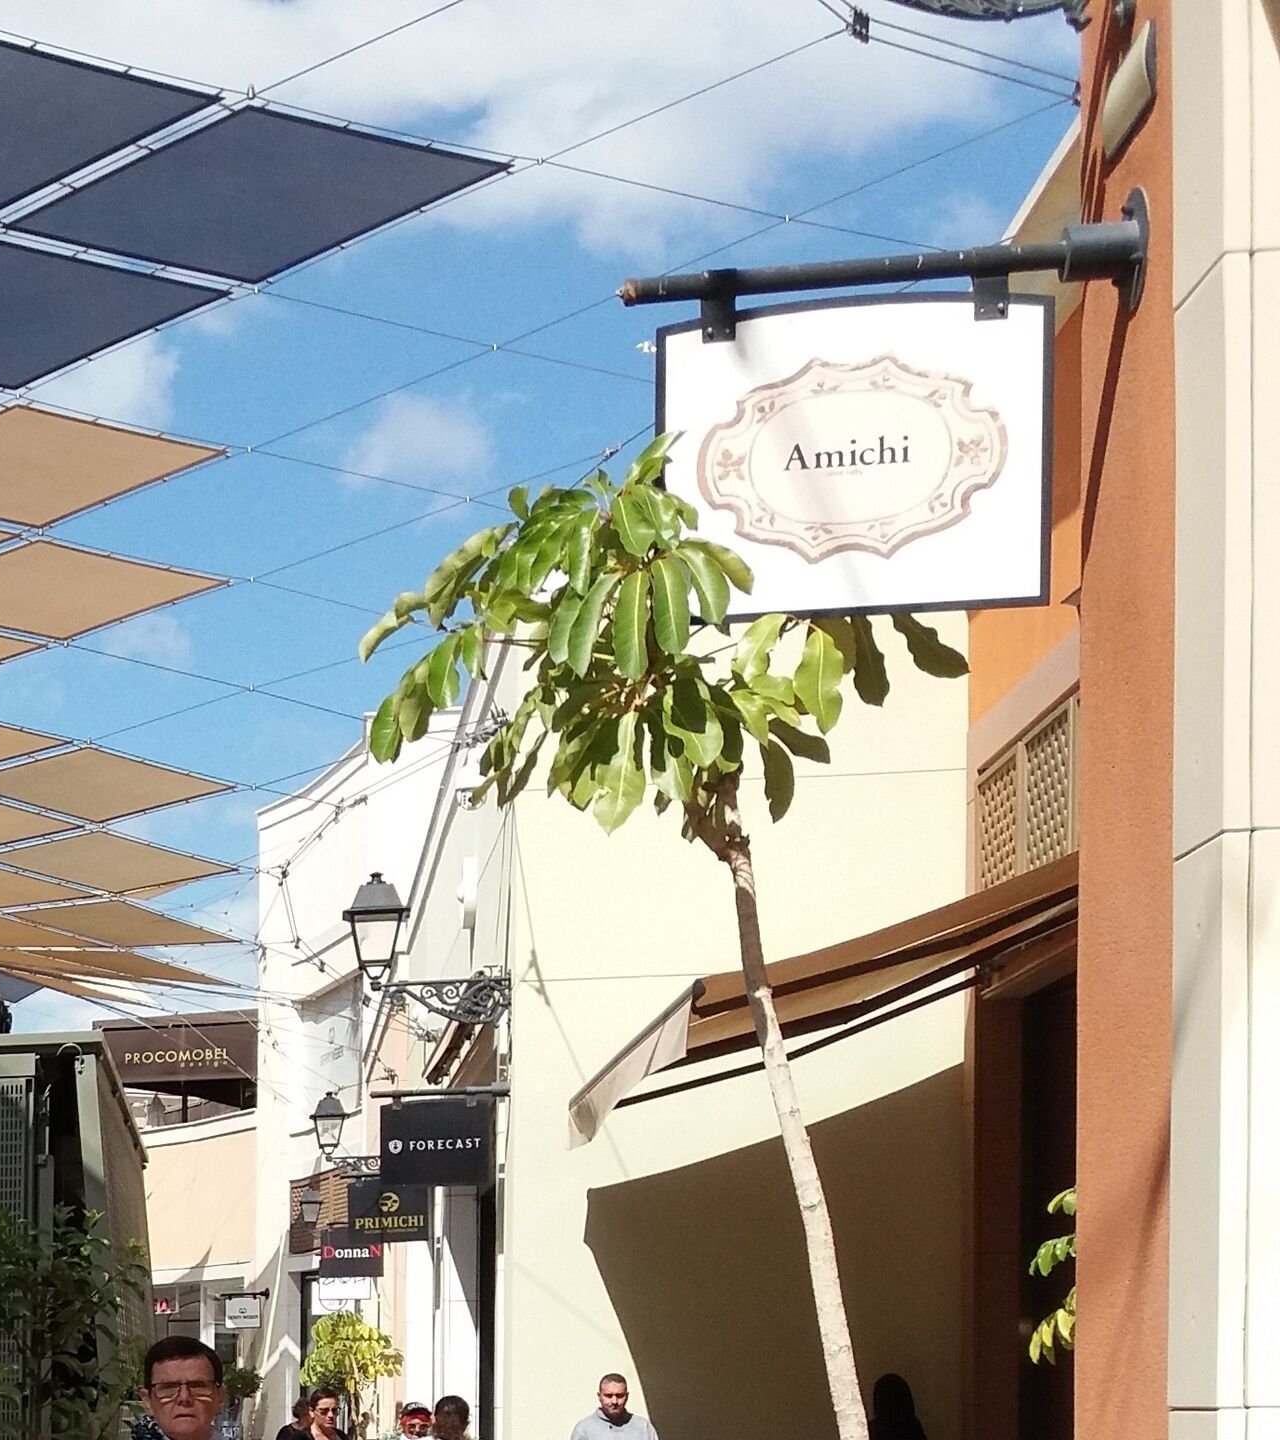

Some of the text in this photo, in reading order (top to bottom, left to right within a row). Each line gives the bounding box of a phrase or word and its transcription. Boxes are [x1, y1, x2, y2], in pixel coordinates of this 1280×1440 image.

[782, 434, 912, 472] Amichi
[124, 1047, 229, 1064] PROCOMOBEL
[408, 1137, 482, 1151] FORECAST
[354, 1214, 425, 1230] PRIMICHI
[322, 1244, 383, 1259] DonnaN
